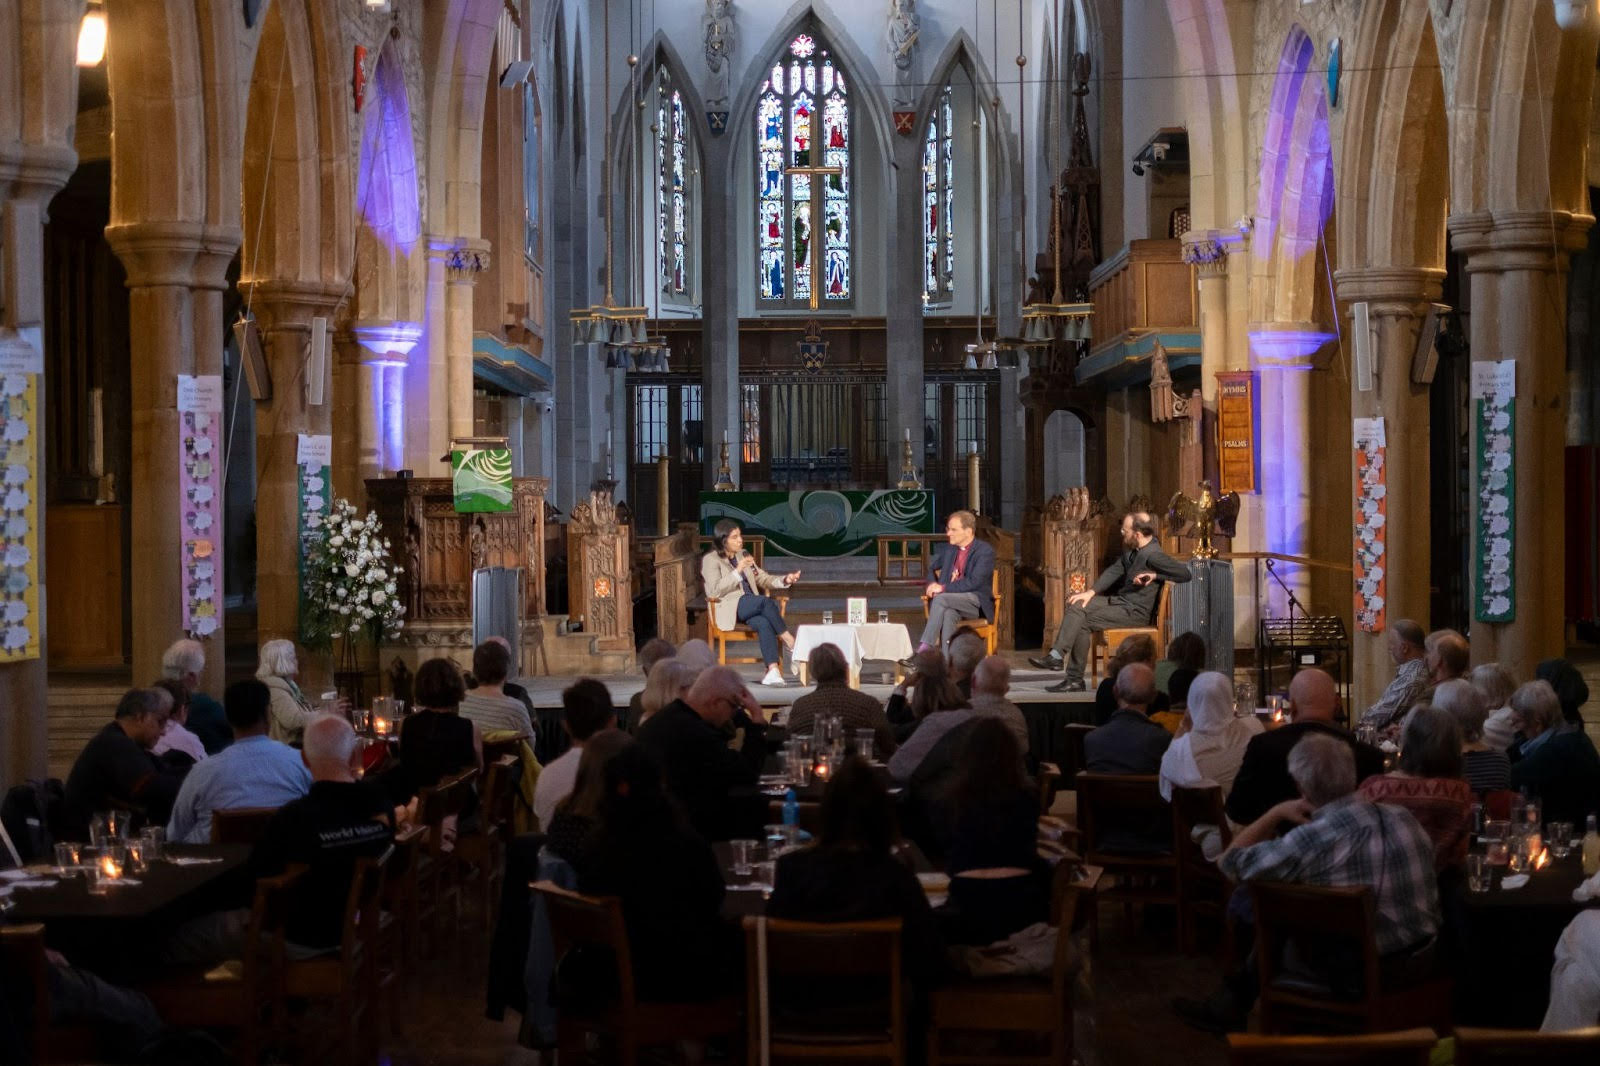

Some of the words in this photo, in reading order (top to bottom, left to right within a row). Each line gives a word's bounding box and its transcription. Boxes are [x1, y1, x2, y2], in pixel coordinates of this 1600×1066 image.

[1223, 386, 1247, 394] HYMNS
[1224, 440, 1247, 448] PSALMS
[319, 827, 353, 841] World
[354, 824, 383, 835] Vision
